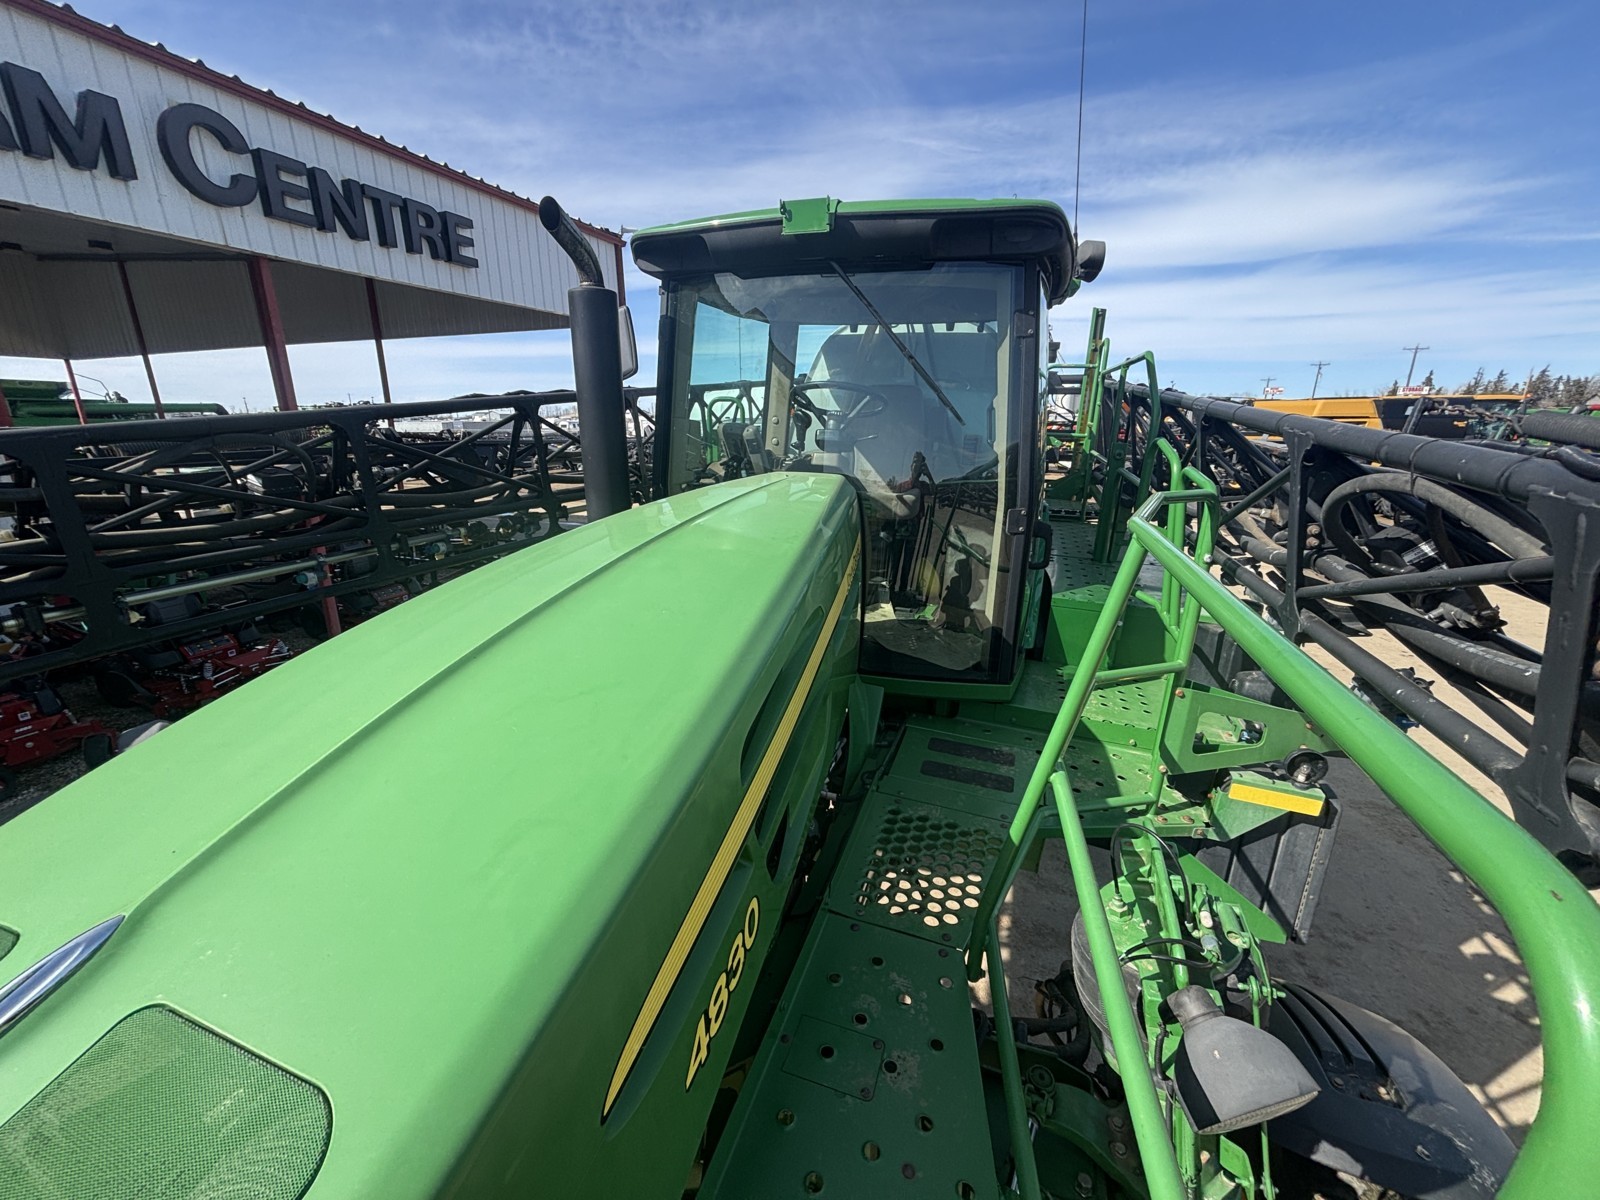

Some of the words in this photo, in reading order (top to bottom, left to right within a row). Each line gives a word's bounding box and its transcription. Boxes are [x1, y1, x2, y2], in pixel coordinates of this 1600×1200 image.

[0, 61, 138, 181] M
[157, 103, 479, 268] CENTRE
[685, 896, 760, 1092] 4830
